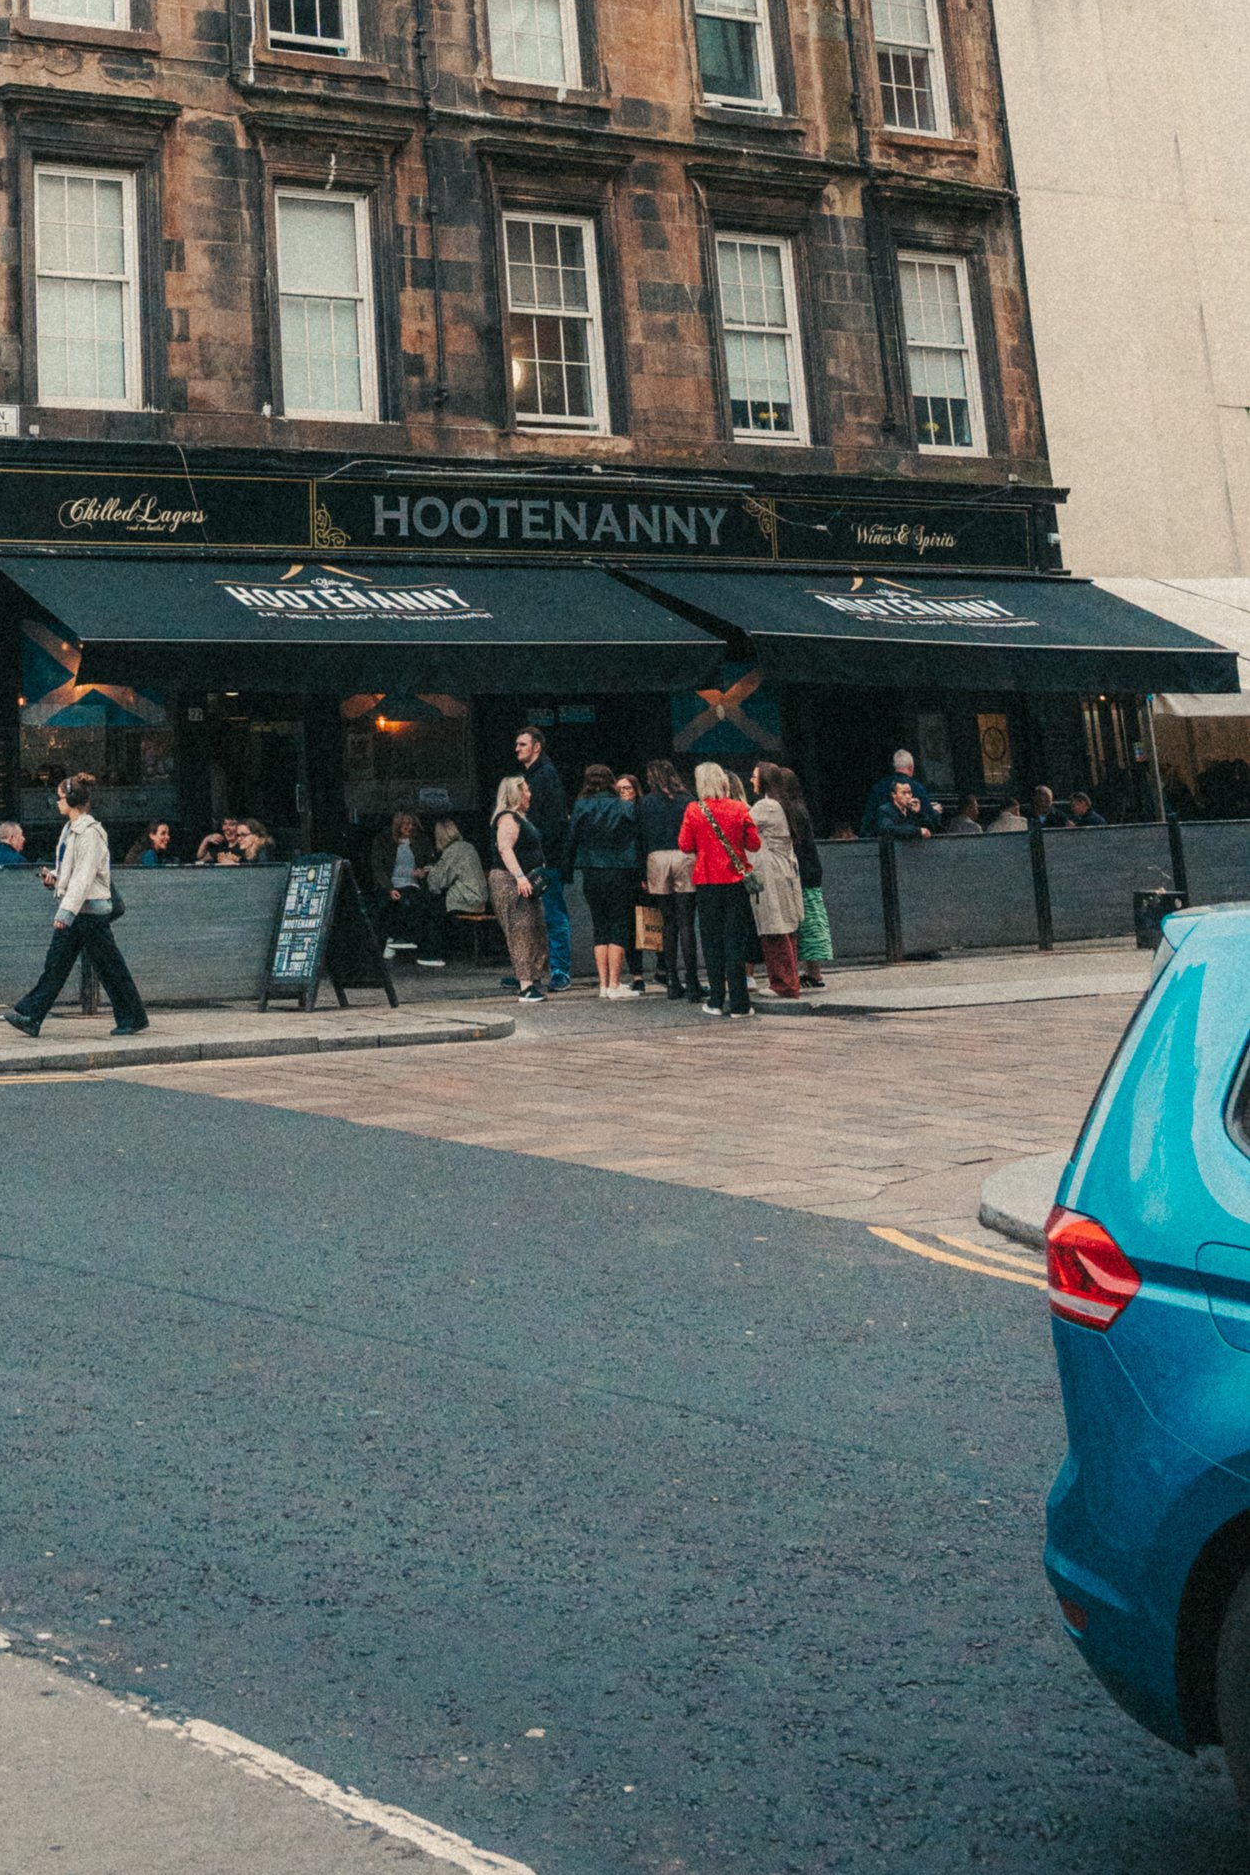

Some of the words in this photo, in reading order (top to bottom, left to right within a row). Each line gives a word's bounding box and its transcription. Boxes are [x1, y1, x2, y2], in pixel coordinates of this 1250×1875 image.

[58, 496, 141, 530] Chilled
[135, 493, 208, 533] Lagers
[373, 495, 728, 546] HOOTENANNY
[851, 523, 893, 545] Wines
[894, 524, 911, 545] &
[912, 524, 957, 555] Spirits
[224, 586, 471, 610] HOOTENANNY
[815, 594, 1015, 617] HOOTENANNY
[403, 612, 495, 621] ENTERTAINMENT
